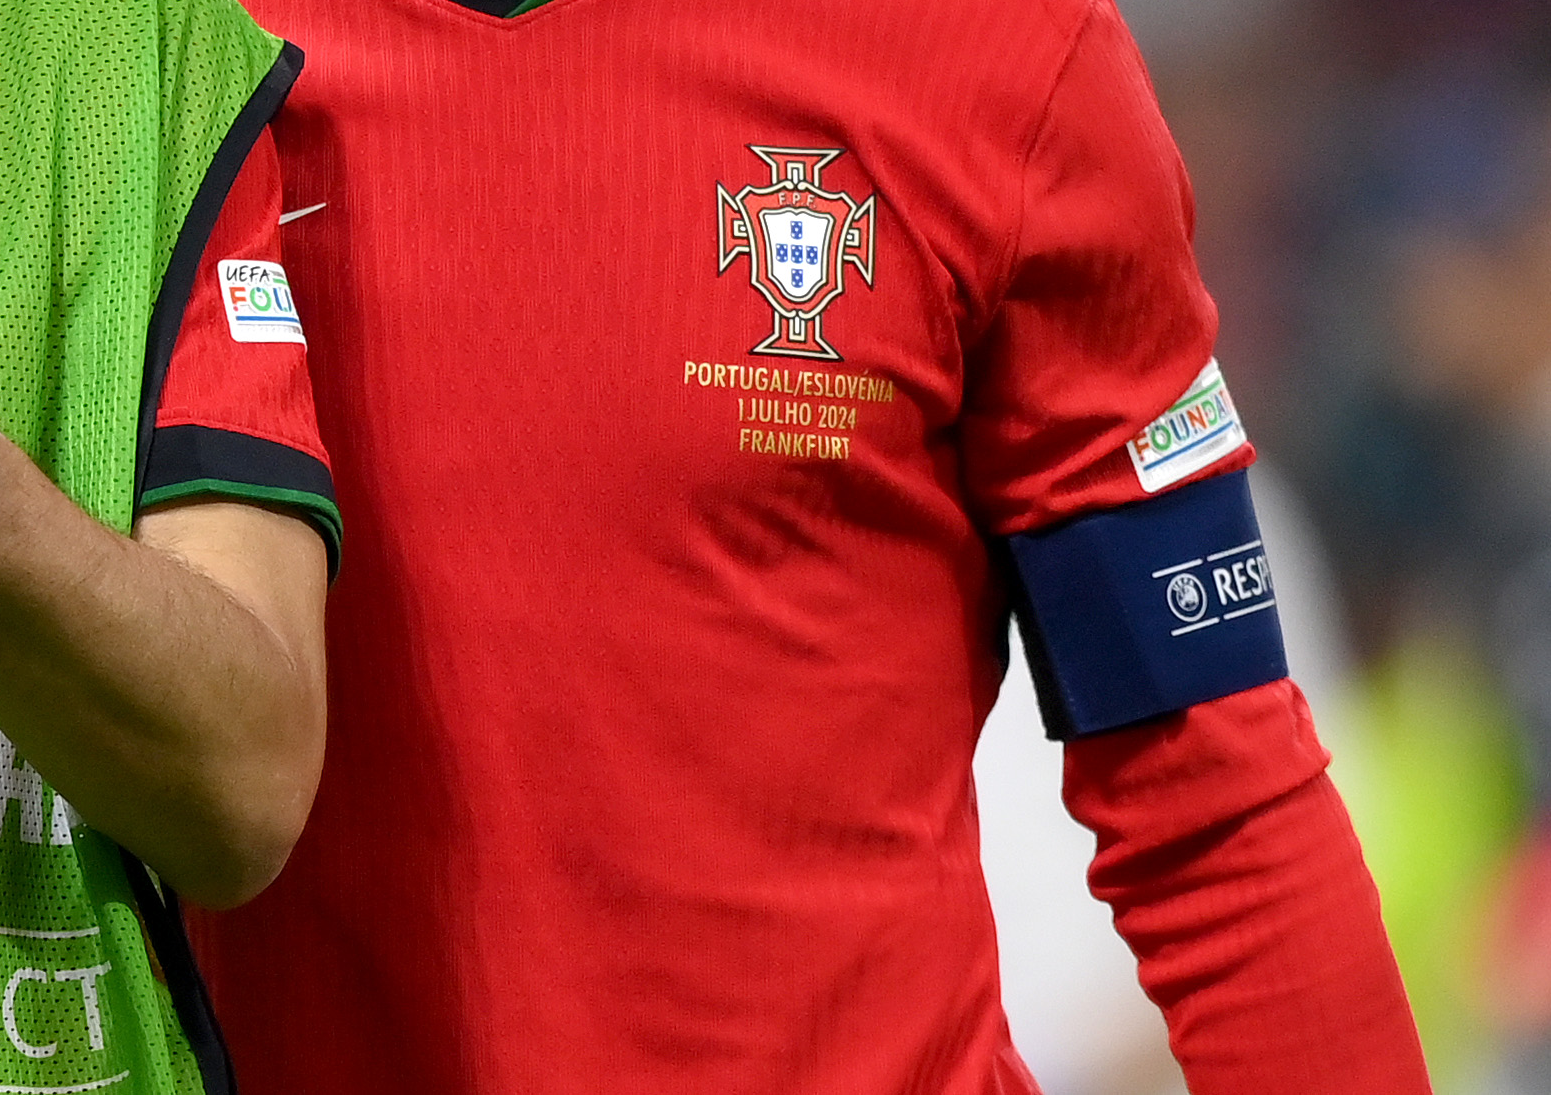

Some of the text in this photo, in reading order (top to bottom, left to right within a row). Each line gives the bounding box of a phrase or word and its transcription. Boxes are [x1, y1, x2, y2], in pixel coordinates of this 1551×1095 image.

[226, 265, 270, 283] UEFA
[738, 398, 857, 429] 1 JULHO 2024
[1133, 389, 1233, 462] FOUNDA
[739, 429, 850, 460] FRANKFURT
[1212, 555, 1273, 605] RESP
